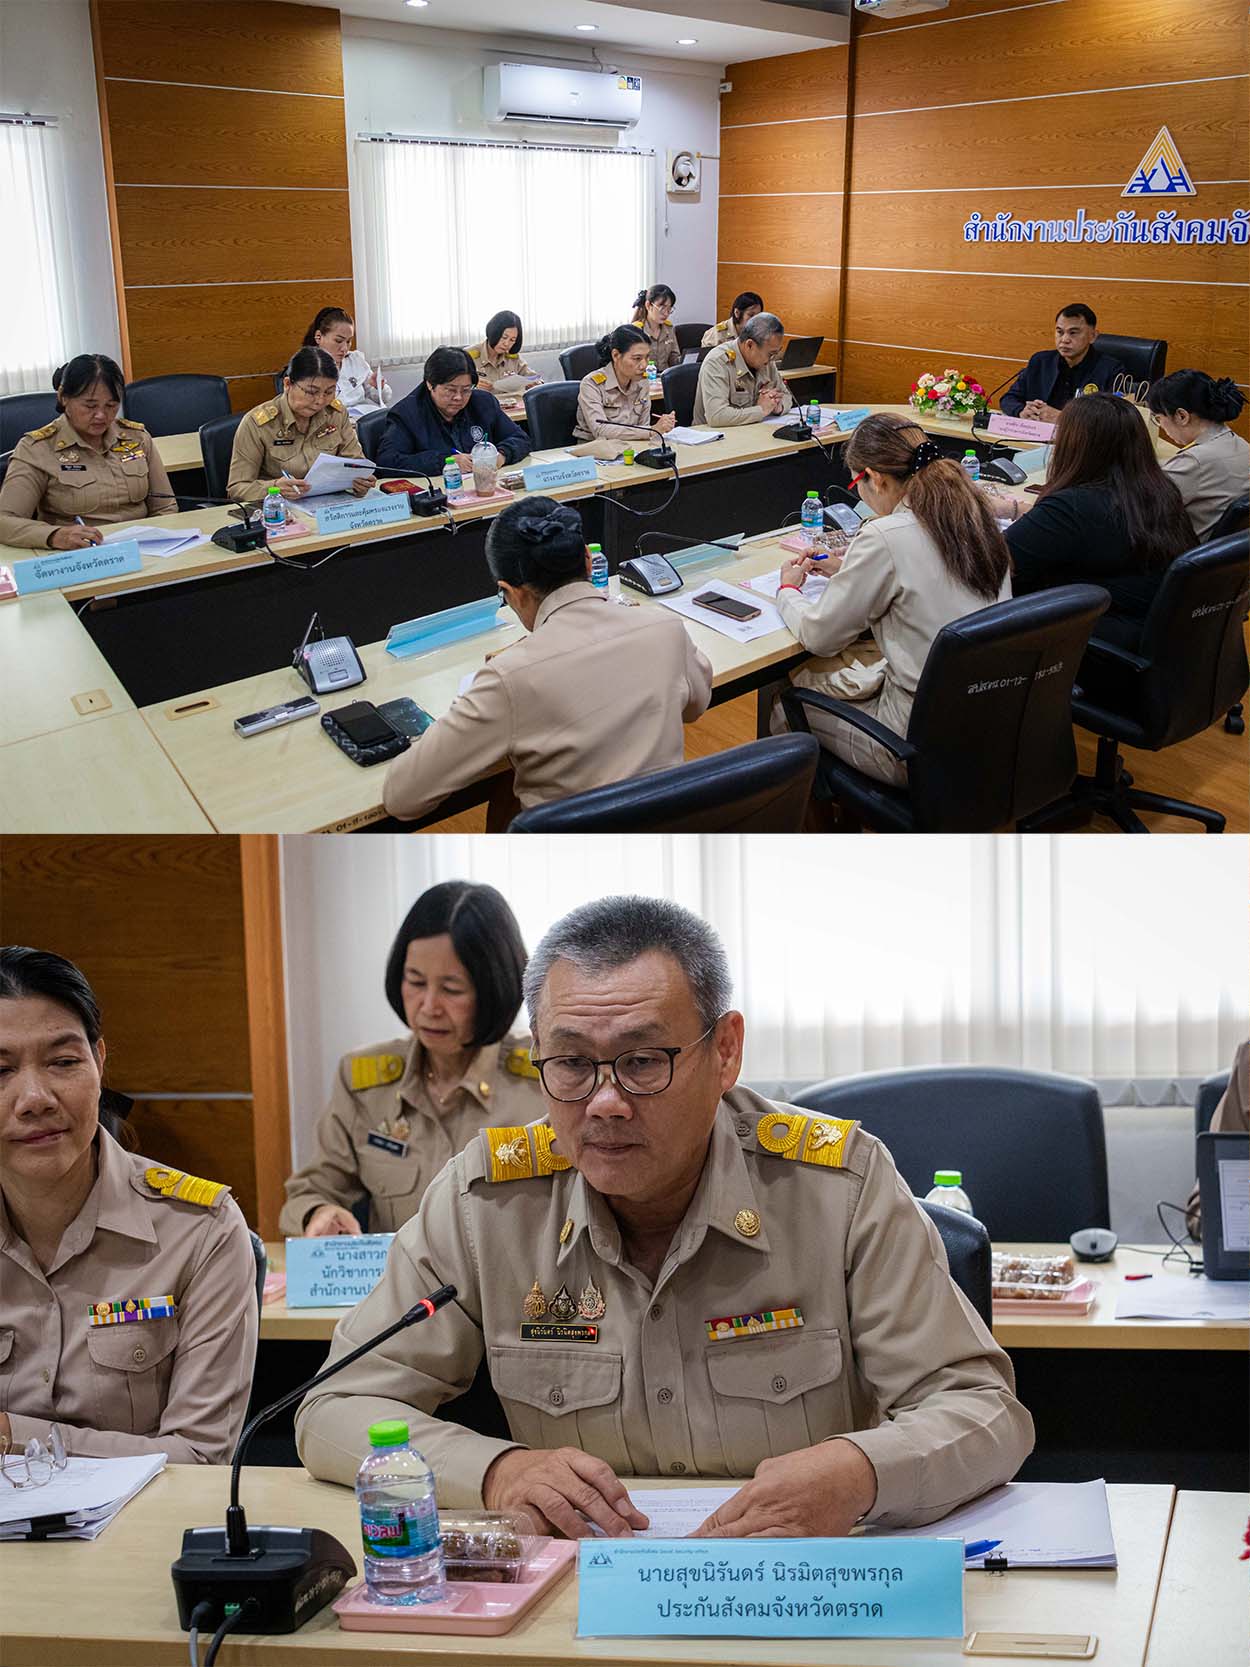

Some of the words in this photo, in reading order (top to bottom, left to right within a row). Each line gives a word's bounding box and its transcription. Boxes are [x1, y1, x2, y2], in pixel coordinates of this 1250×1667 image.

[34, 554, 125, 580] จัดหางานจังหวัดตราด
[322, 1266, 384, 1278] นักวิชาการ
[638, 1560, 765, 1588] นายสุขนิรันดร์
[772, 1561, 903, 1588] นิรมิตสุขพรกุล
[657, 1594, 883, 1618] ประกันสังคมจังหวัดตราด
